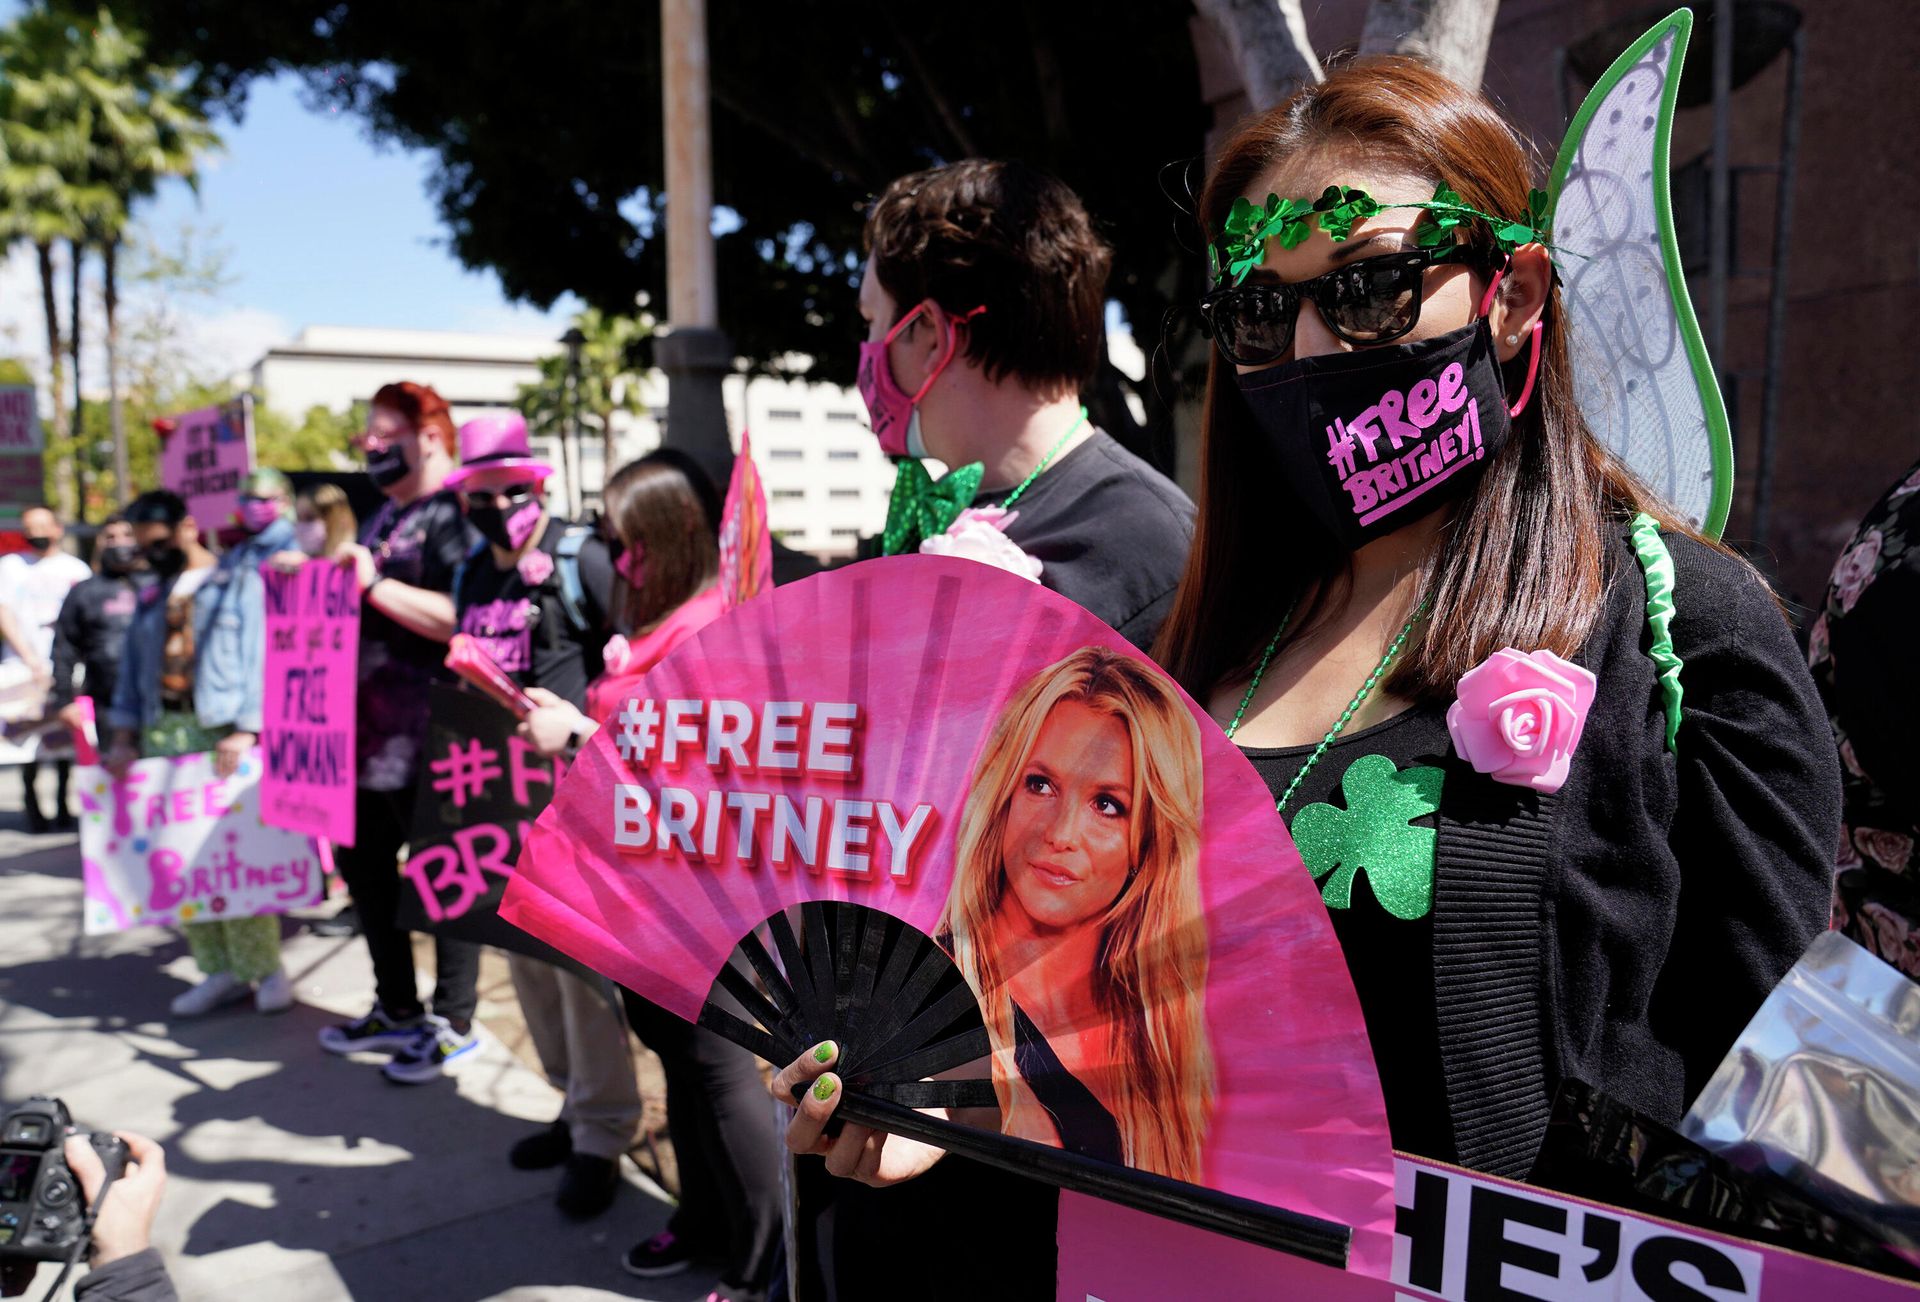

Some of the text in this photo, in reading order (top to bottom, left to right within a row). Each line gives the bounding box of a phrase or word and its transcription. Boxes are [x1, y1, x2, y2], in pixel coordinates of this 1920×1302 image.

[1342, 397, 1485, 514] BRITNEY!
[283, 668, 328, 725] FREE
[615, 698, 860, 776] #FREE
[111, 771, 236, 836] FREE
[613, 783, 934, 880] BRITNEY
